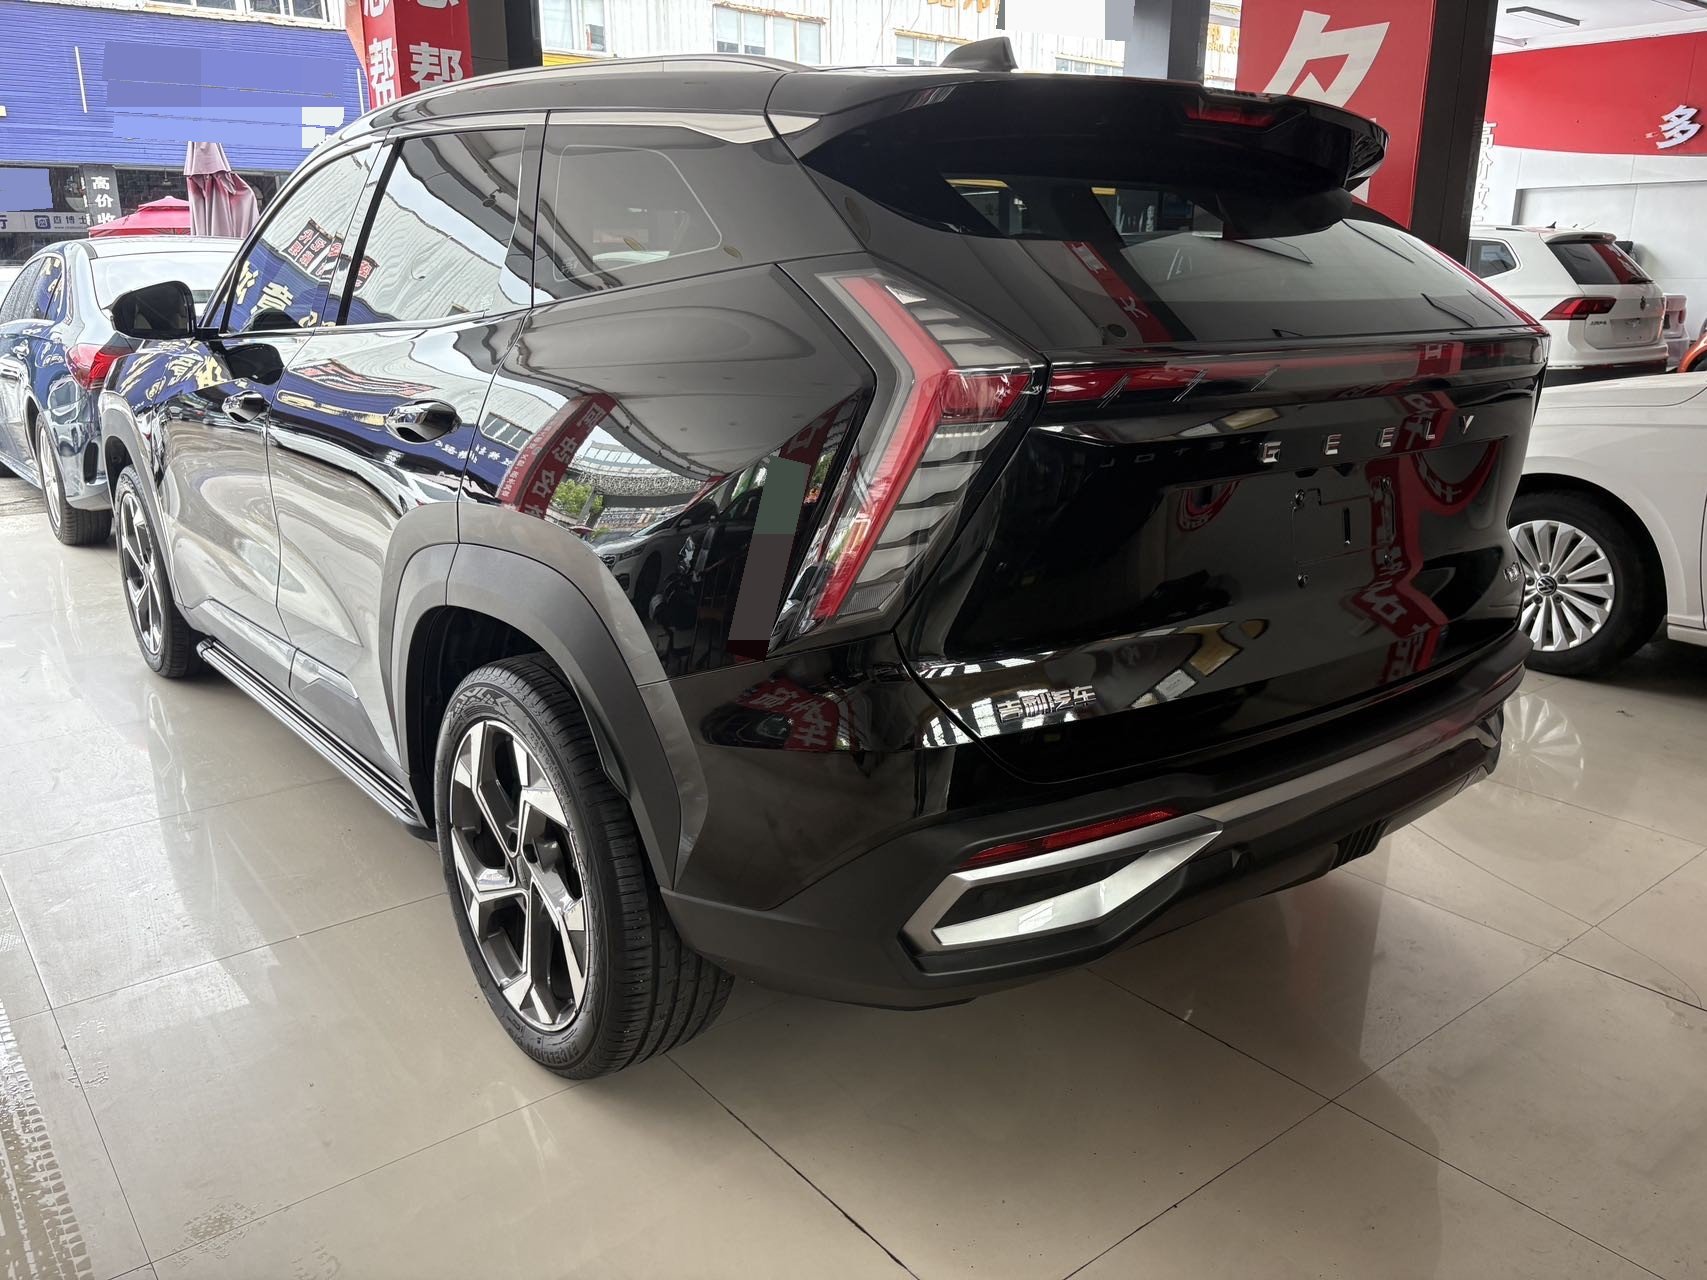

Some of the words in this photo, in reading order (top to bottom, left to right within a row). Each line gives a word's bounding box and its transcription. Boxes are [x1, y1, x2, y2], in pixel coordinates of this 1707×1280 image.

[1656, 104, 1702, 149] 多
[1260, 415, 1474, 463] GEELY
[997, 685, 1096, 723] 吉利汽车
